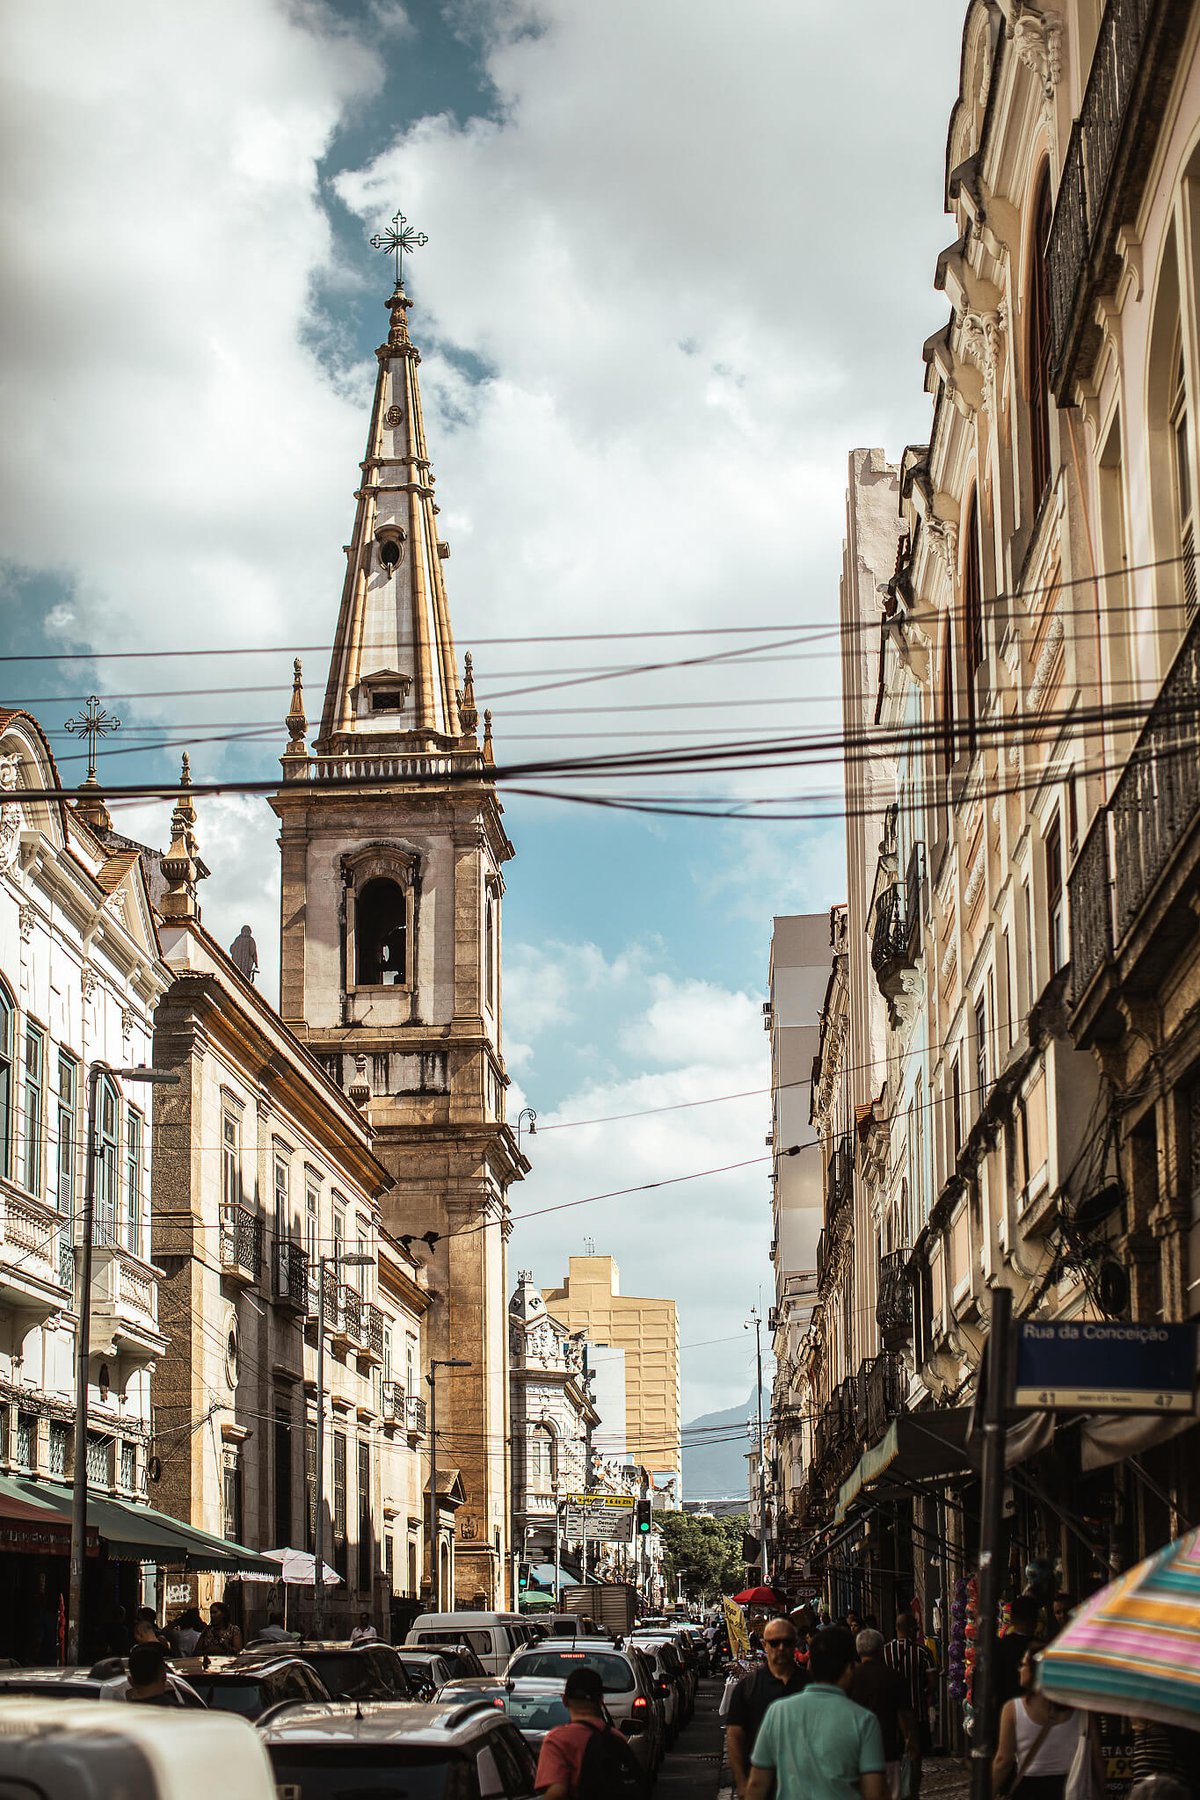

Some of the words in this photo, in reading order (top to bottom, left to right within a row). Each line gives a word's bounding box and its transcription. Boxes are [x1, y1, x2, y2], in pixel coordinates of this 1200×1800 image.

[1023, 1323, 1054, 1340] Rua
[1058, 1324, 1080, 1340] da
[1083, 1324, 1169, 1344] Conceição
[1038, 1392, 1056, 1405] 41
[1154, 1395, 1173, 1408] 47
